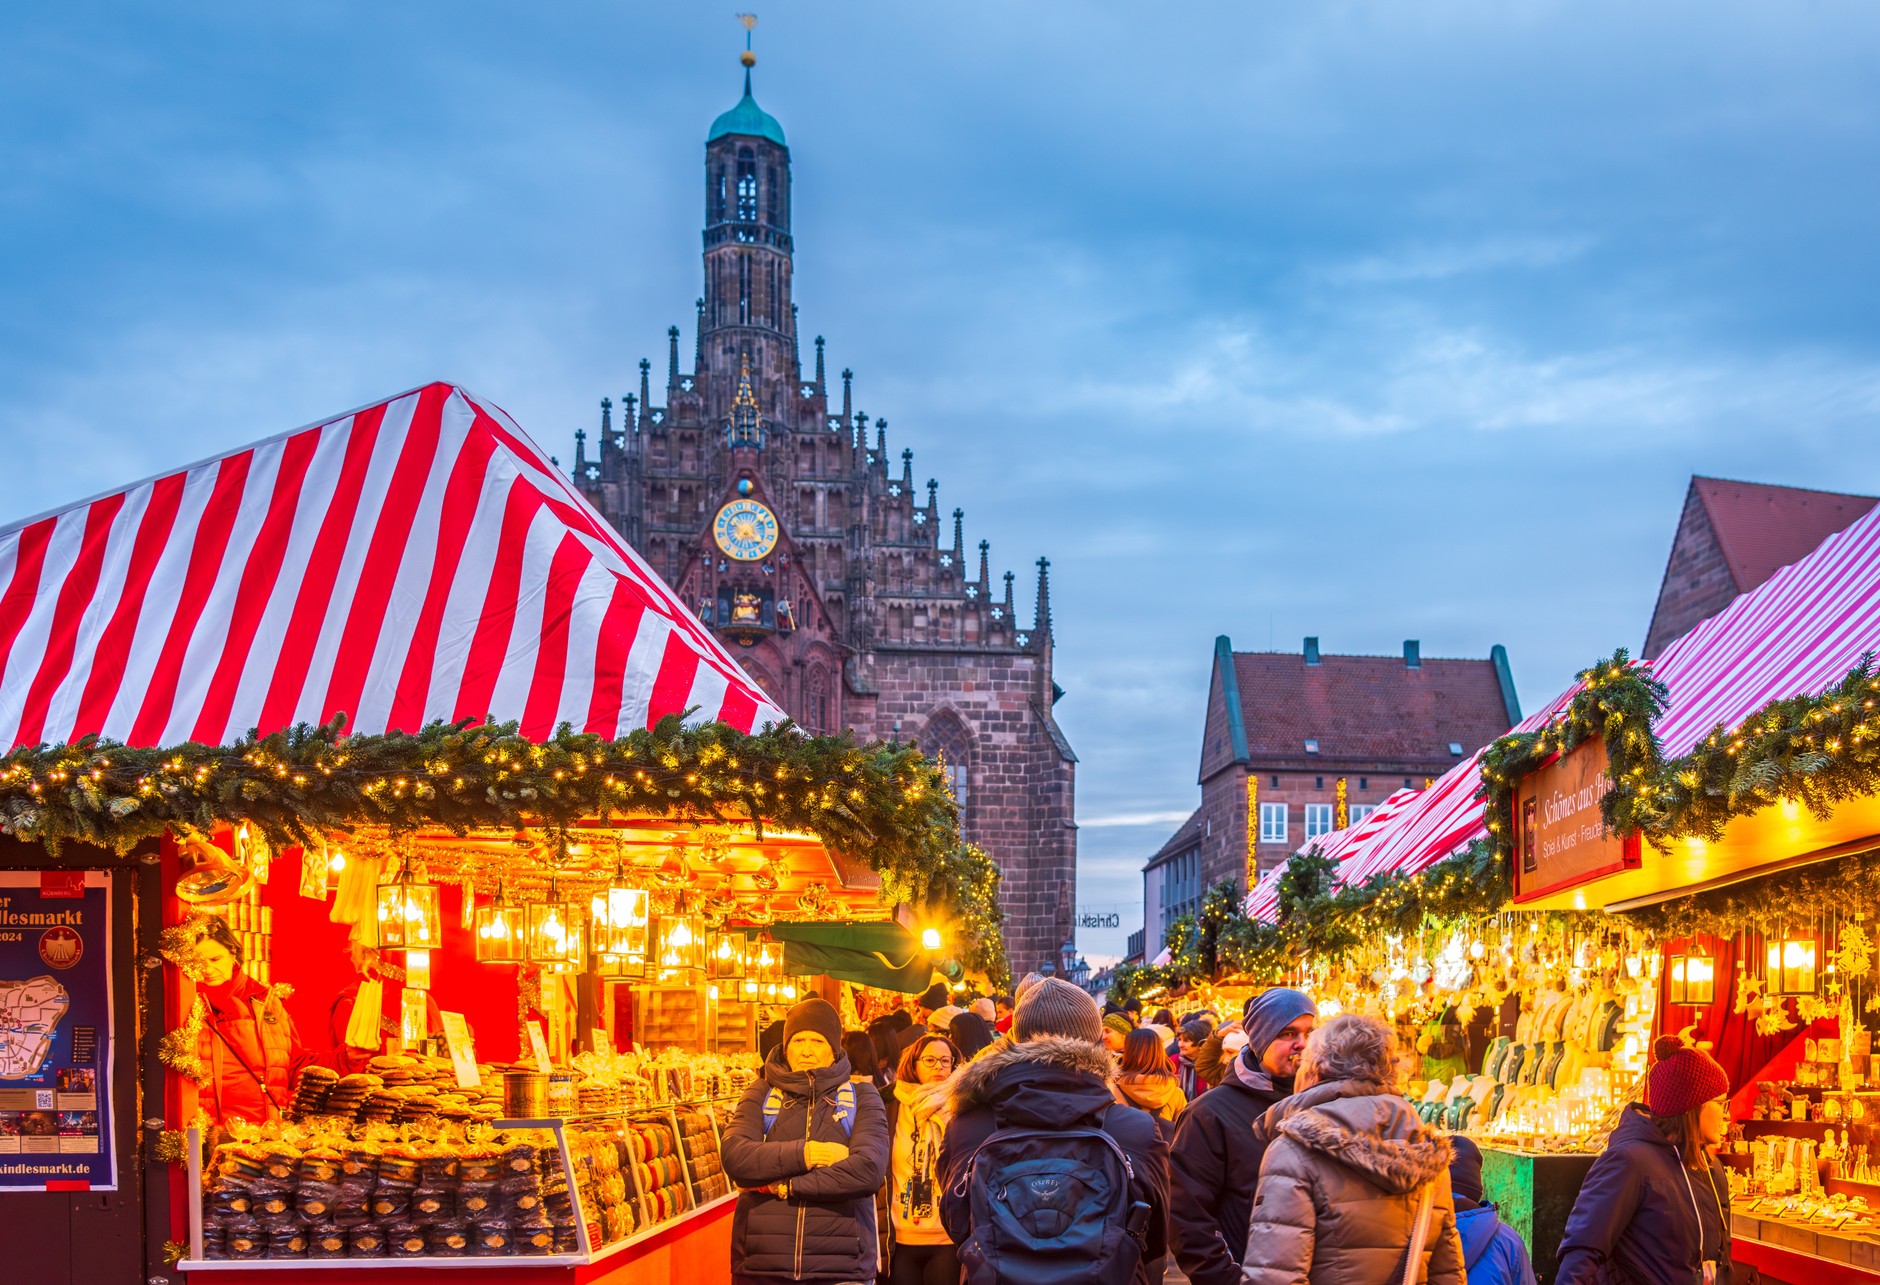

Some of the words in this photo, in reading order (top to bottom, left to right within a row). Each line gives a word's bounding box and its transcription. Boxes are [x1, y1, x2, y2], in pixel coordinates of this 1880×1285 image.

[1543, 790, 1576, 829] Schönes
[1578, 785, 1594, 811] aus
[1543, 837, 1556, 861] Spiel
[1561, 829, 1577, 851] Kunst
[0, 909, 83, 925] lesmarkt
[0, 932, 22, 942] 024
[1031, 1179, 1060, 1187] OSPREY
